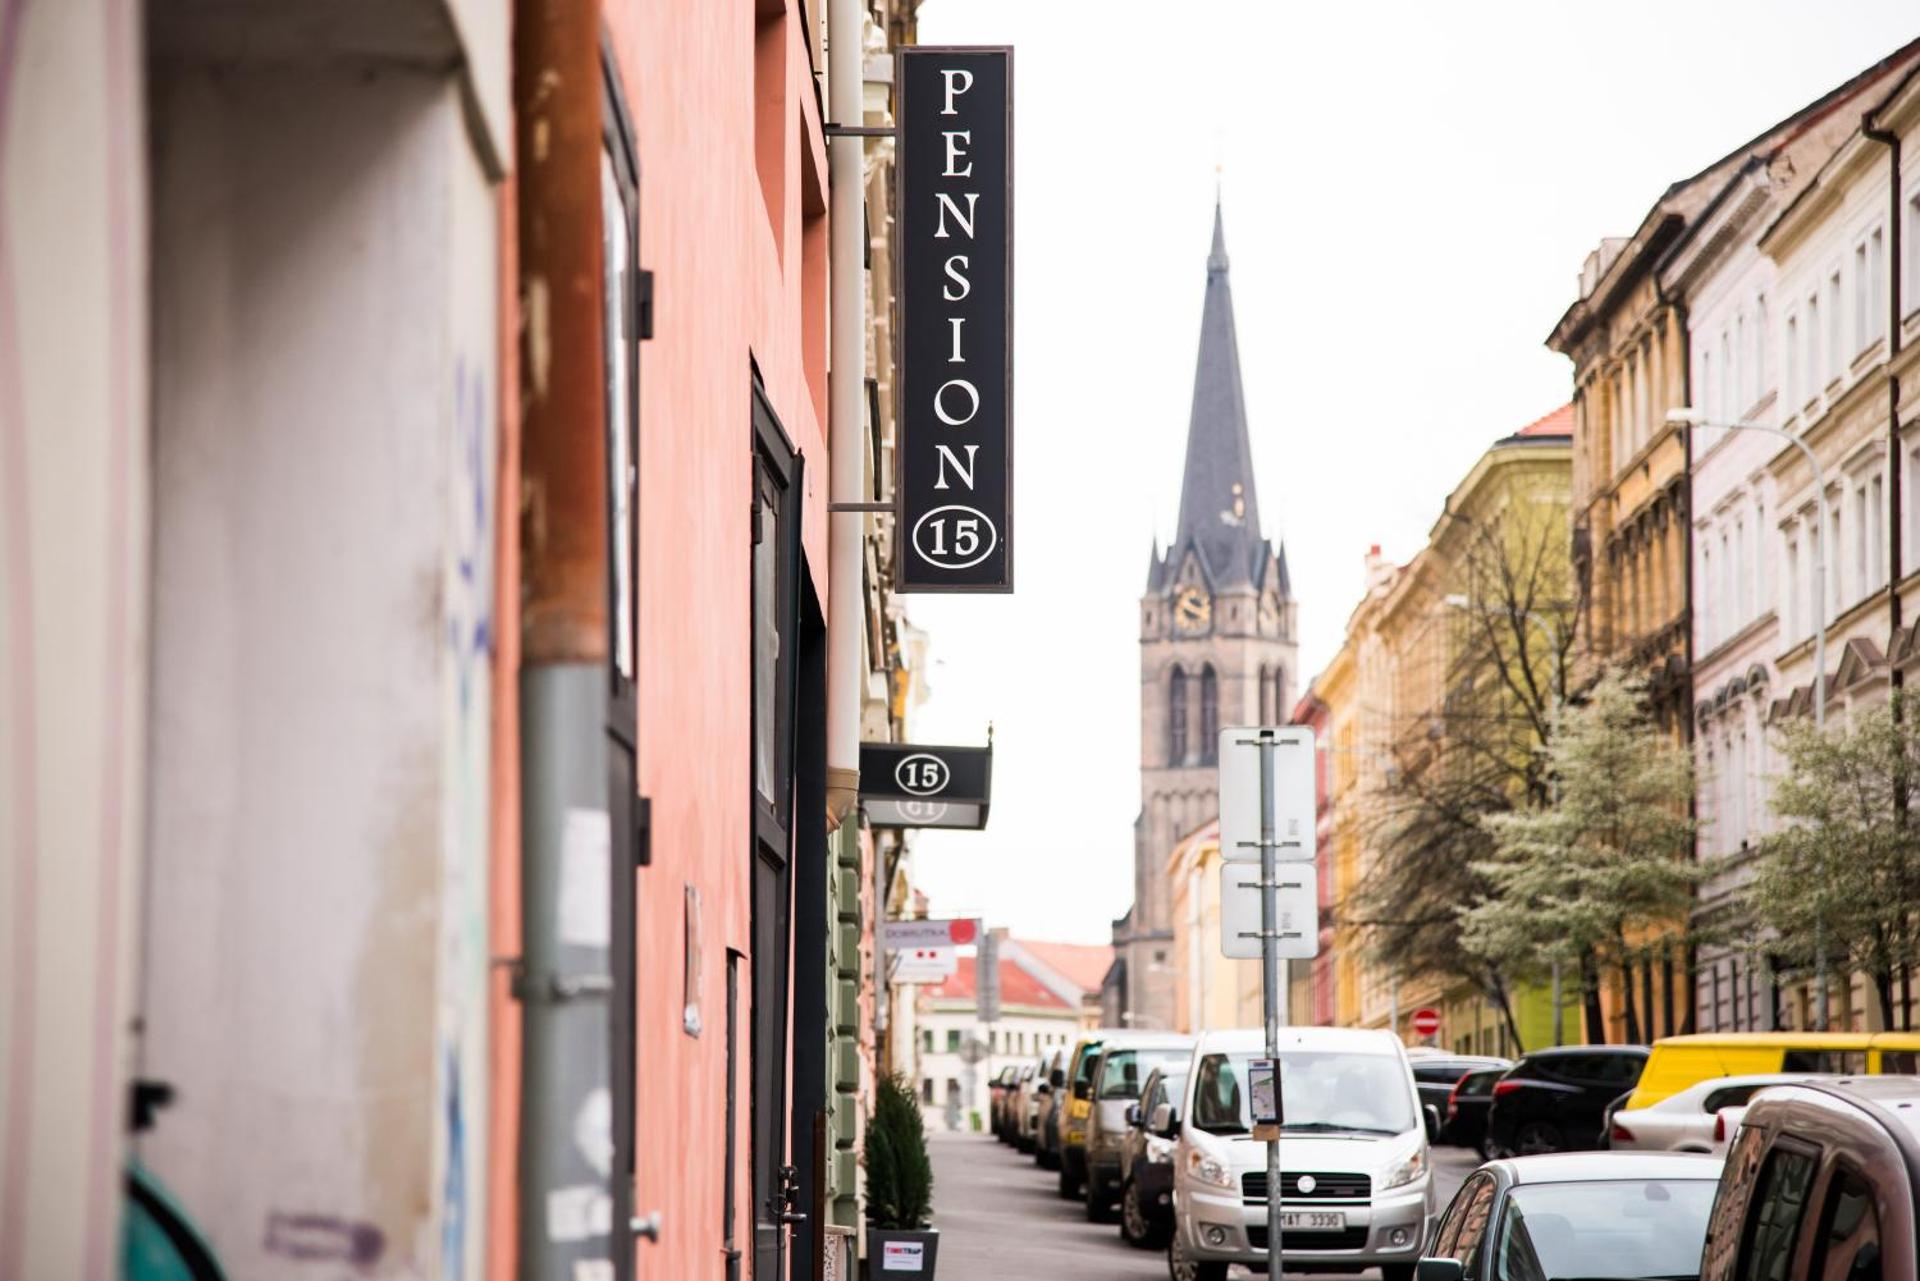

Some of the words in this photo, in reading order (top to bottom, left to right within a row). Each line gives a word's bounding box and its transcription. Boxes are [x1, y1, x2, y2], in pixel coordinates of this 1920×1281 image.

[934, 70, 979, 490] PENSION
[930, 519, 979, 556] 15
[906, 763, 939, 787] 15
